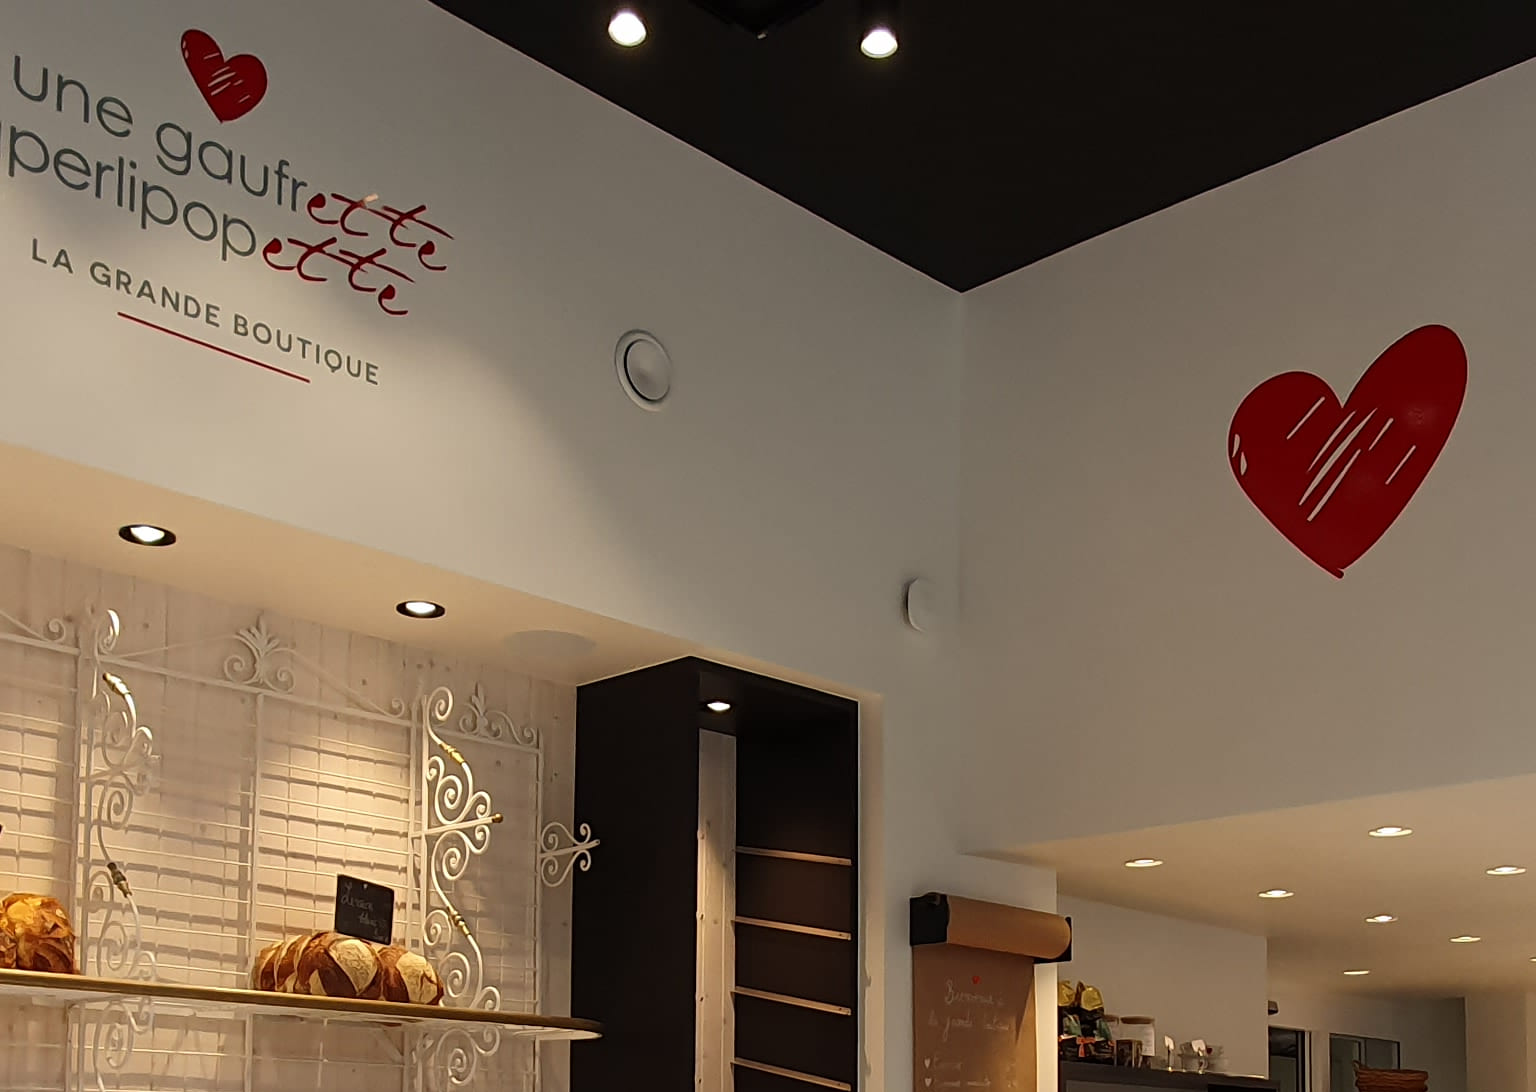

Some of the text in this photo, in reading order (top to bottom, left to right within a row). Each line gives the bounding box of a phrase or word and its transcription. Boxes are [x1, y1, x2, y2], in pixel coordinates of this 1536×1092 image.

[13, 54, 454, 271] une gaufrette
[31, 237, 380, 386] LA GRANDE BOUTIQUE
